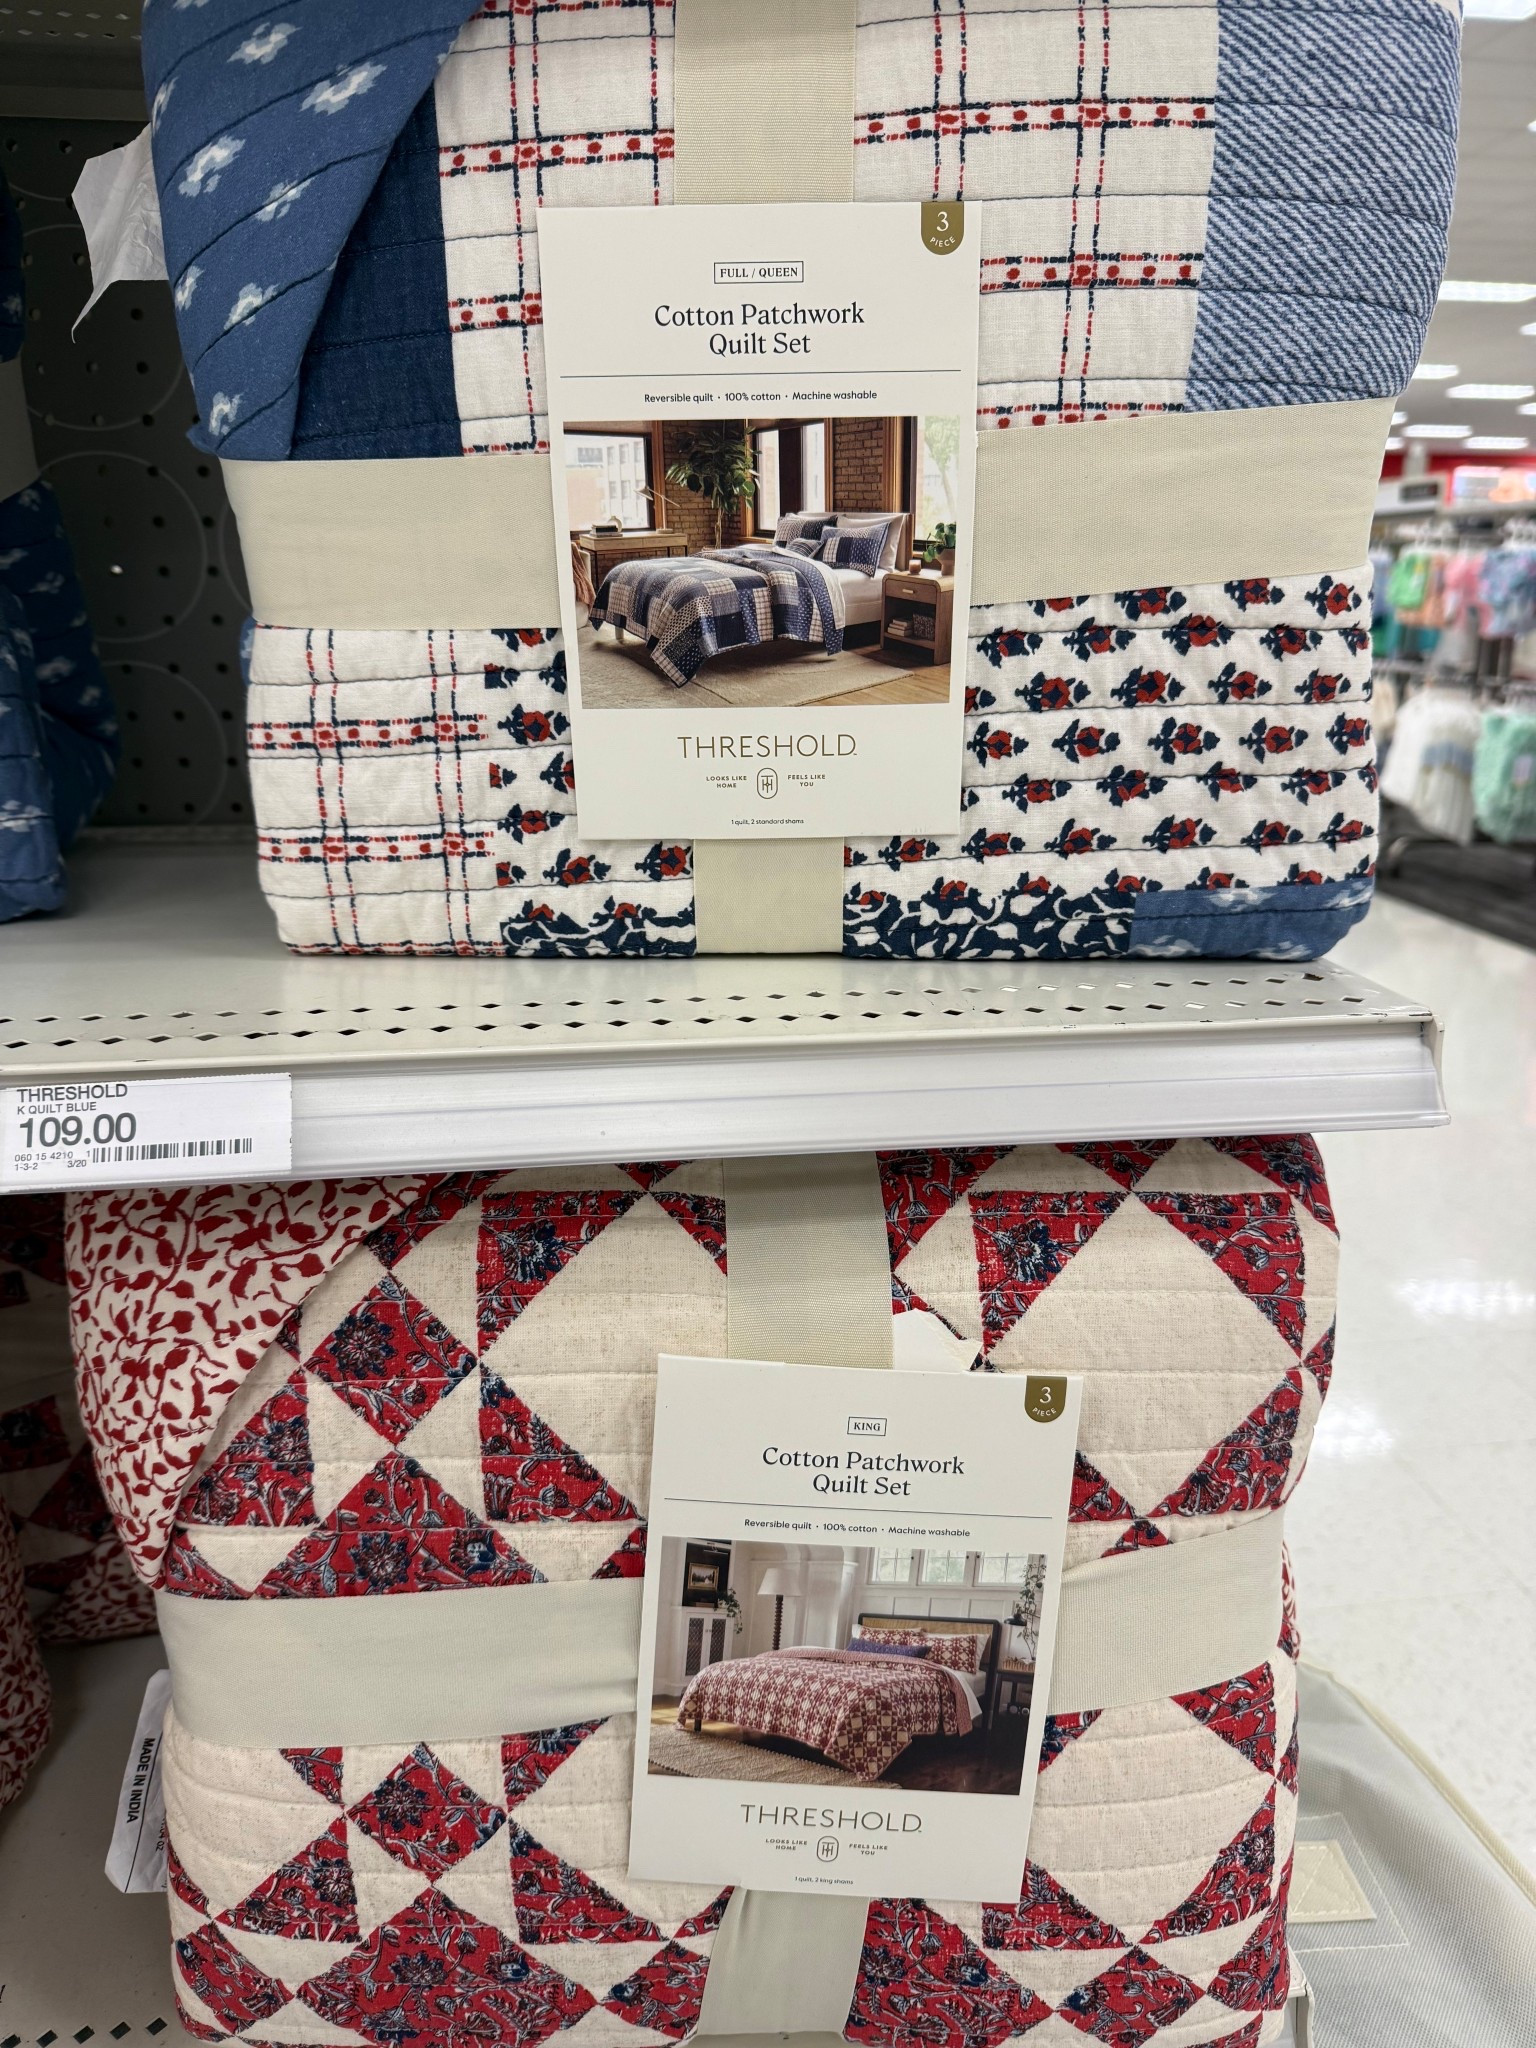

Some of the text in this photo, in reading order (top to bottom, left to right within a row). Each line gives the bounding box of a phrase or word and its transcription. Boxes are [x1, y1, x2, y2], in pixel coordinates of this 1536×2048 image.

[937, 212, 948, 231] 3
[930, 237, 955, 247] PIECE
[720, 268, 749, 278] FULL
[759, 268, 797, 278] QUEEN
[655, 302, 864, 326] Cotton Patchwork
[710, 332, 810, 357] Quilt Set
[644, 390, 878, 404] Reversible quilt 100% cotton Machine washable
[677, 734, 857, 758] THRESHOLD
[16, 1083, 128, 1103] THRESHOLD
[17, 1102, 96, 1115] K QUILT BLUE
[20, 1112, 136, 1149] 109.00
[14, 1153, 33, 1162] 060
[35, 1152, 47, 1161] 15
[49, 1151, 74, 1160] 4210
[14, 1159, 87, 1171] 1-3-2 3/20
[1040, 1387, 1051, 1403] 3
[1032, 1407, 1057, 1417] PIECE
[853, 1422, 881, 1432] KING
[763, 1447, 964, 1474] Cotton Patchwork
[813, 1474, 911, 1495] Quilt Set
[744, 1518, 971, 1537] Reversible quilt 100% cotton Machine washable
[126, 1738, 156, 1824] MADE IN INDIA
[740, 1804, 922, 1833] THRESHOLD
